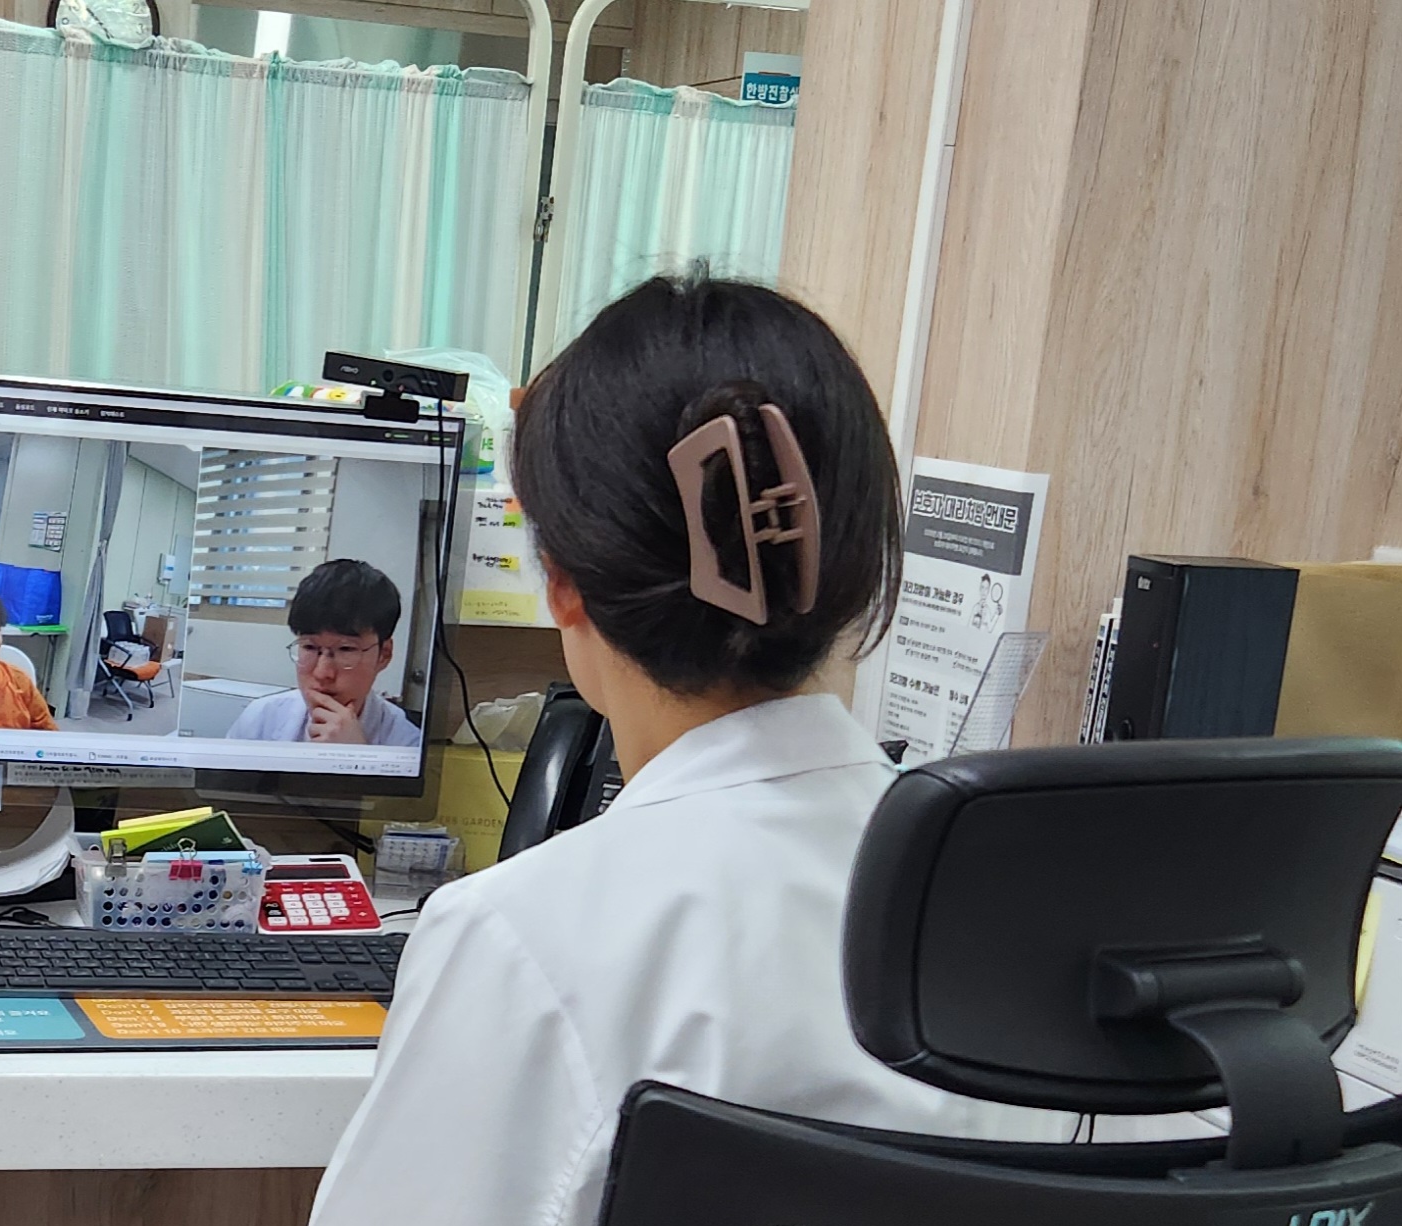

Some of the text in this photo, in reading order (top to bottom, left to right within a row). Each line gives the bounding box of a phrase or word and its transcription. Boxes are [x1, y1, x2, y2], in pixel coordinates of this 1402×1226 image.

[913, 489, 1019, 534] 보호자 대리처방 안내문
